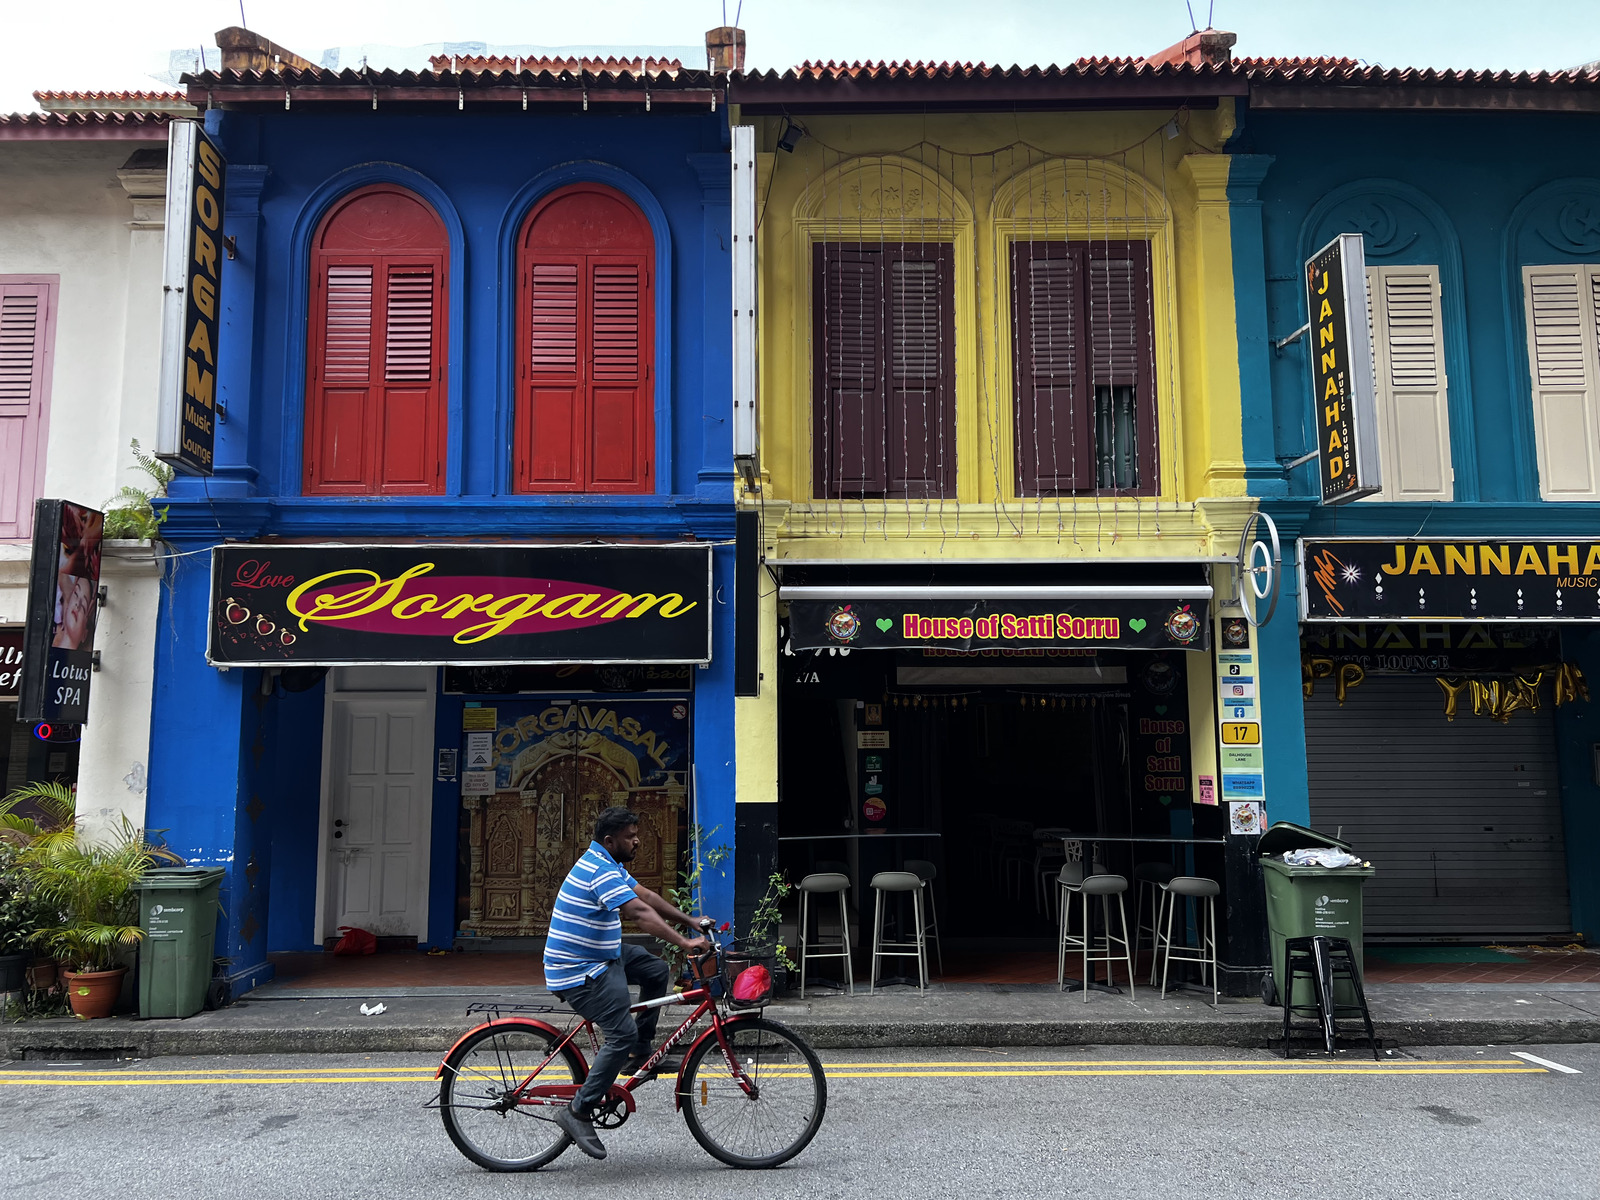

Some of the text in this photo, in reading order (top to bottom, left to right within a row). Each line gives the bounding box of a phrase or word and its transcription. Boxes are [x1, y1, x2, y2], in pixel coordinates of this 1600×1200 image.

[186, 140, 220, 410] SORGAM
[1317, 271, 1344, 480] JANNAHAD
[185, 402, 211, 435] Music
[1338, 371, 1350, 468] MUSIC LOUNGE
[182, 425, 212, 464] Lounge
[231, 559, 295, 589] Love
[1556, 577, 1597, 588] MUSIC
[286, 562, 697, 645] Sorgam
[903, 613, 1120, 639] House of Satti Sorru
[52, 660, 89, 681] Lotus
[54, 686, 81, 706] SPA
[1140, 718, 1185, 735] House
[1233, 726, 1248, 740] 17
[1155, 737, 1171, 753] of
[1147, 756, 1181, 772] Satti
[1145, 775, 1185, 791] Sorru
